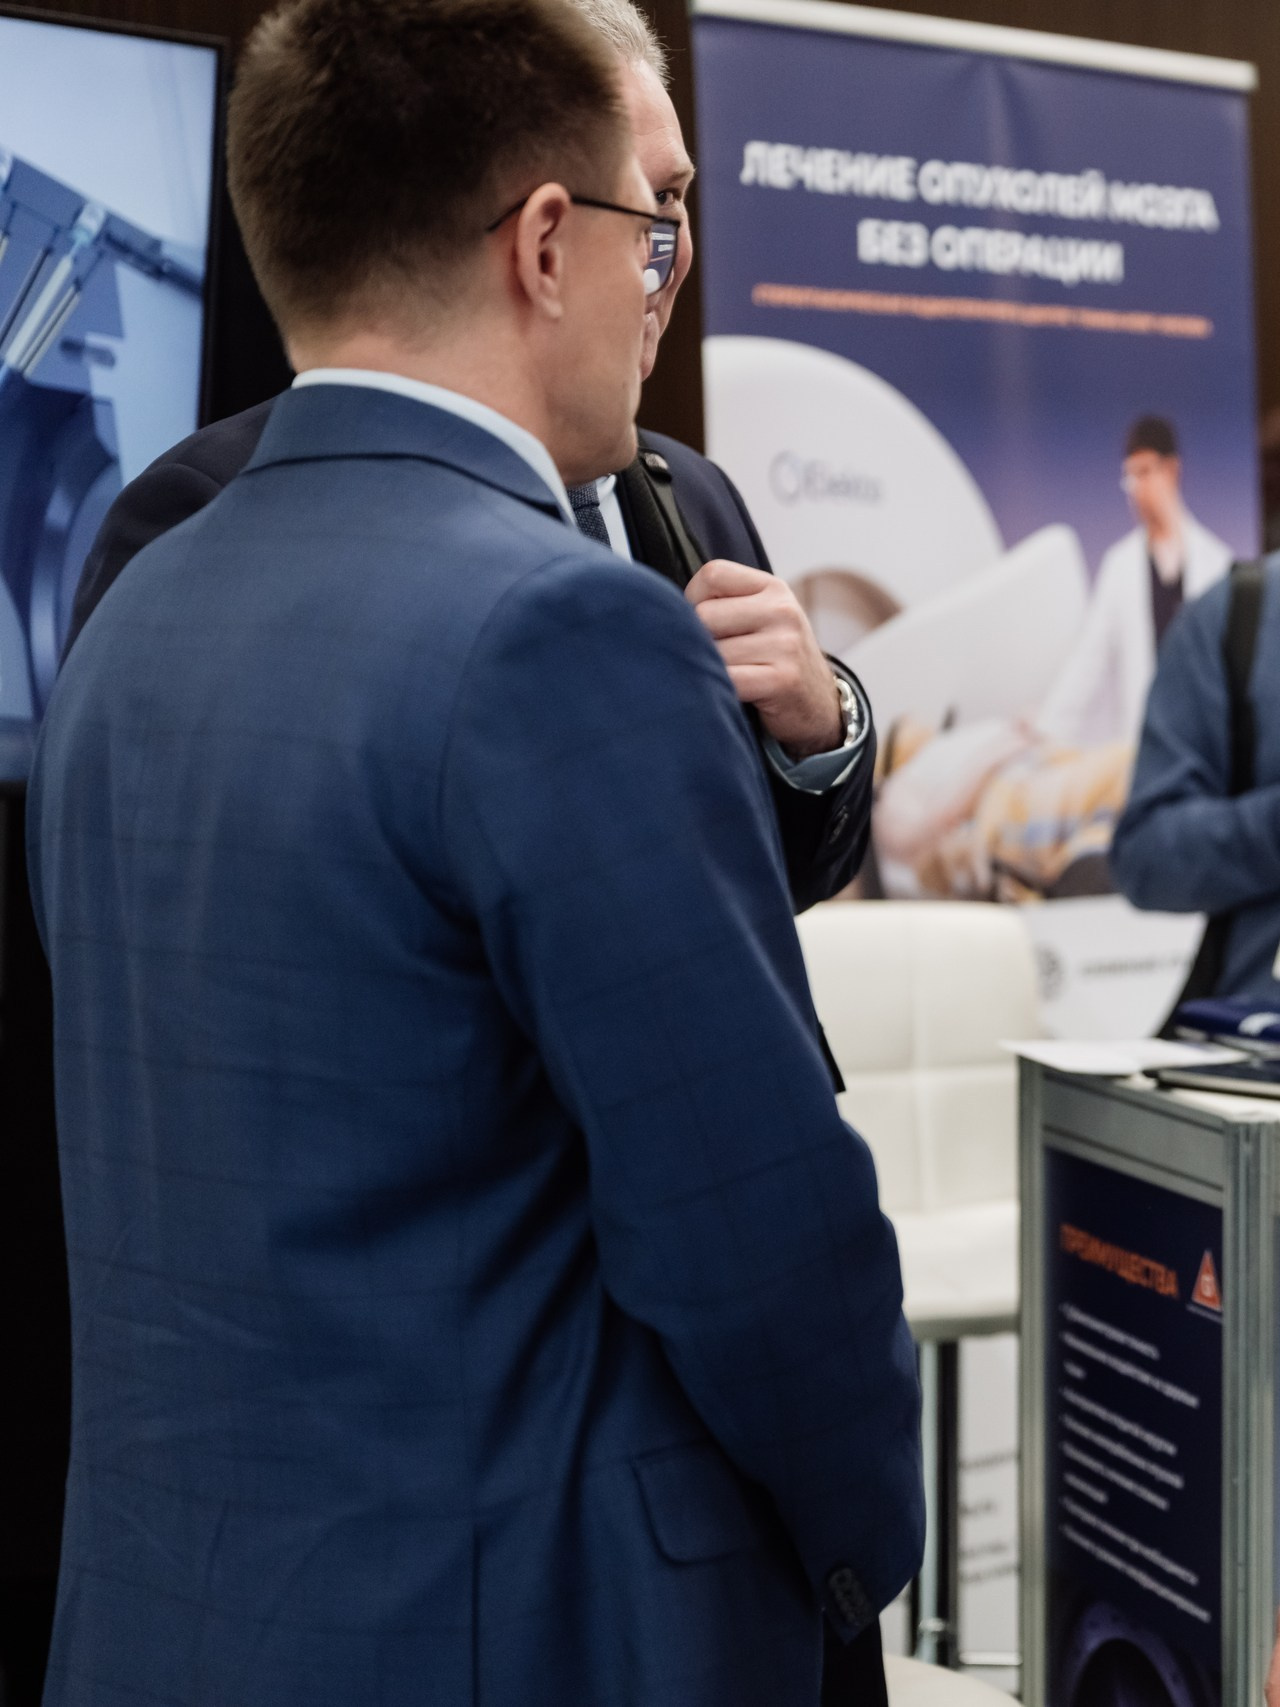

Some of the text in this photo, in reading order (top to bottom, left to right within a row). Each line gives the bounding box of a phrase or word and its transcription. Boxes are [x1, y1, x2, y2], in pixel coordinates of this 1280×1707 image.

[740, 140, 917, 203] ЛЕЧЕНИЕ
[917, 158, 1107, 221] ОПУХОЛЕЙ
[856, 217, 1125, 287] БЕЗ ОПЕРАЦИИ
